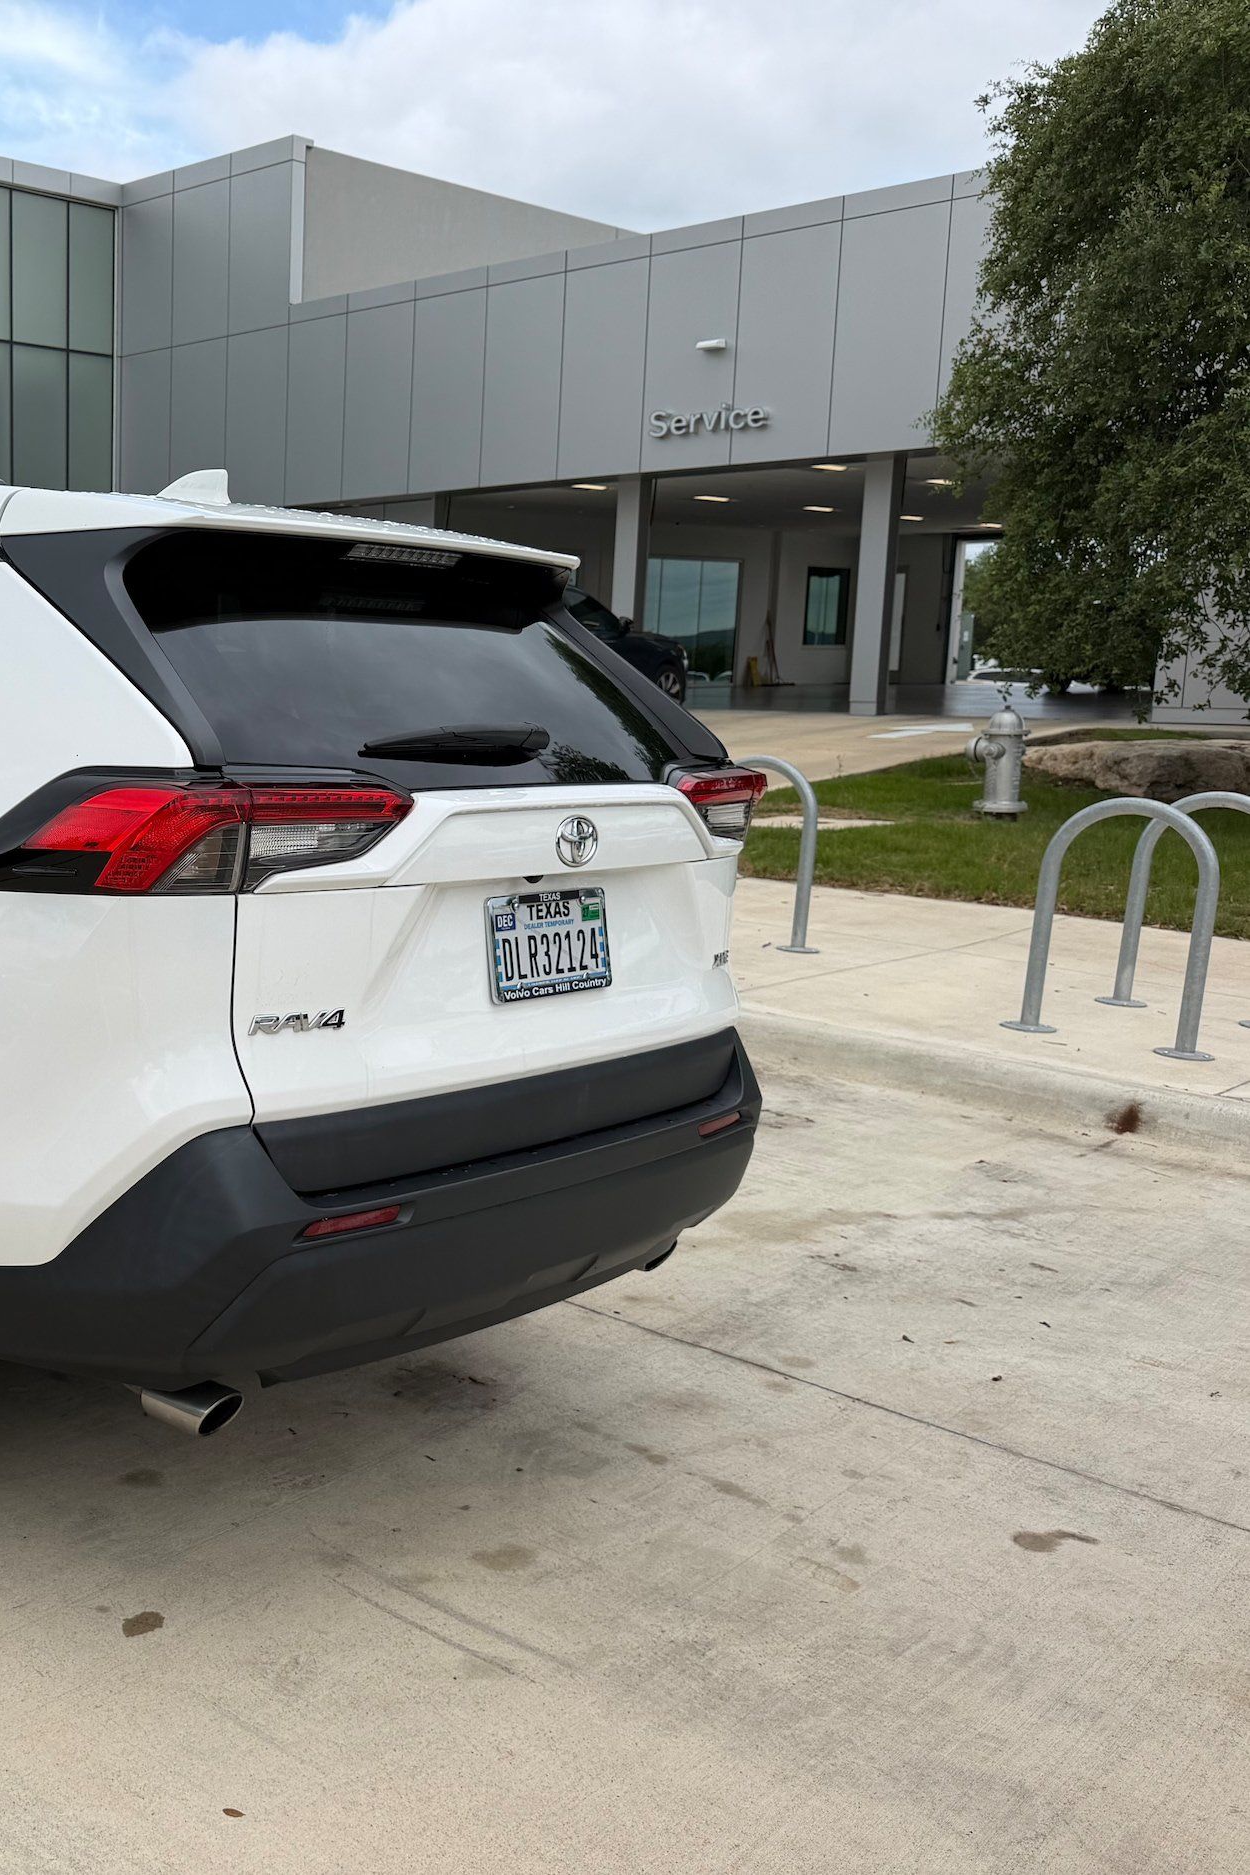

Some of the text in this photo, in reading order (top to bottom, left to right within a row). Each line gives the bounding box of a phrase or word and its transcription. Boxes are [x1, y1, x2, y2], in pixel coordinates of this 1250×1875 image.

[649, 402, 766, 438] Service
[539, 892, 561, 902] TEXAS
[496, 914, 514, 928] DEC
[526, 901, 571, 921] TEXAS
[524, 919, 575, 930] DEALER TEMPORARY
[501, 927, 600, 982] DLR32124
[504, 987, 531, 1001] Volvo
[532, 984, 554, 996] Cars
[556, 981, 571, 993] Hill
[572, 978, 607, 991] Country
[247, 1006, 346, 1036] RAV4
